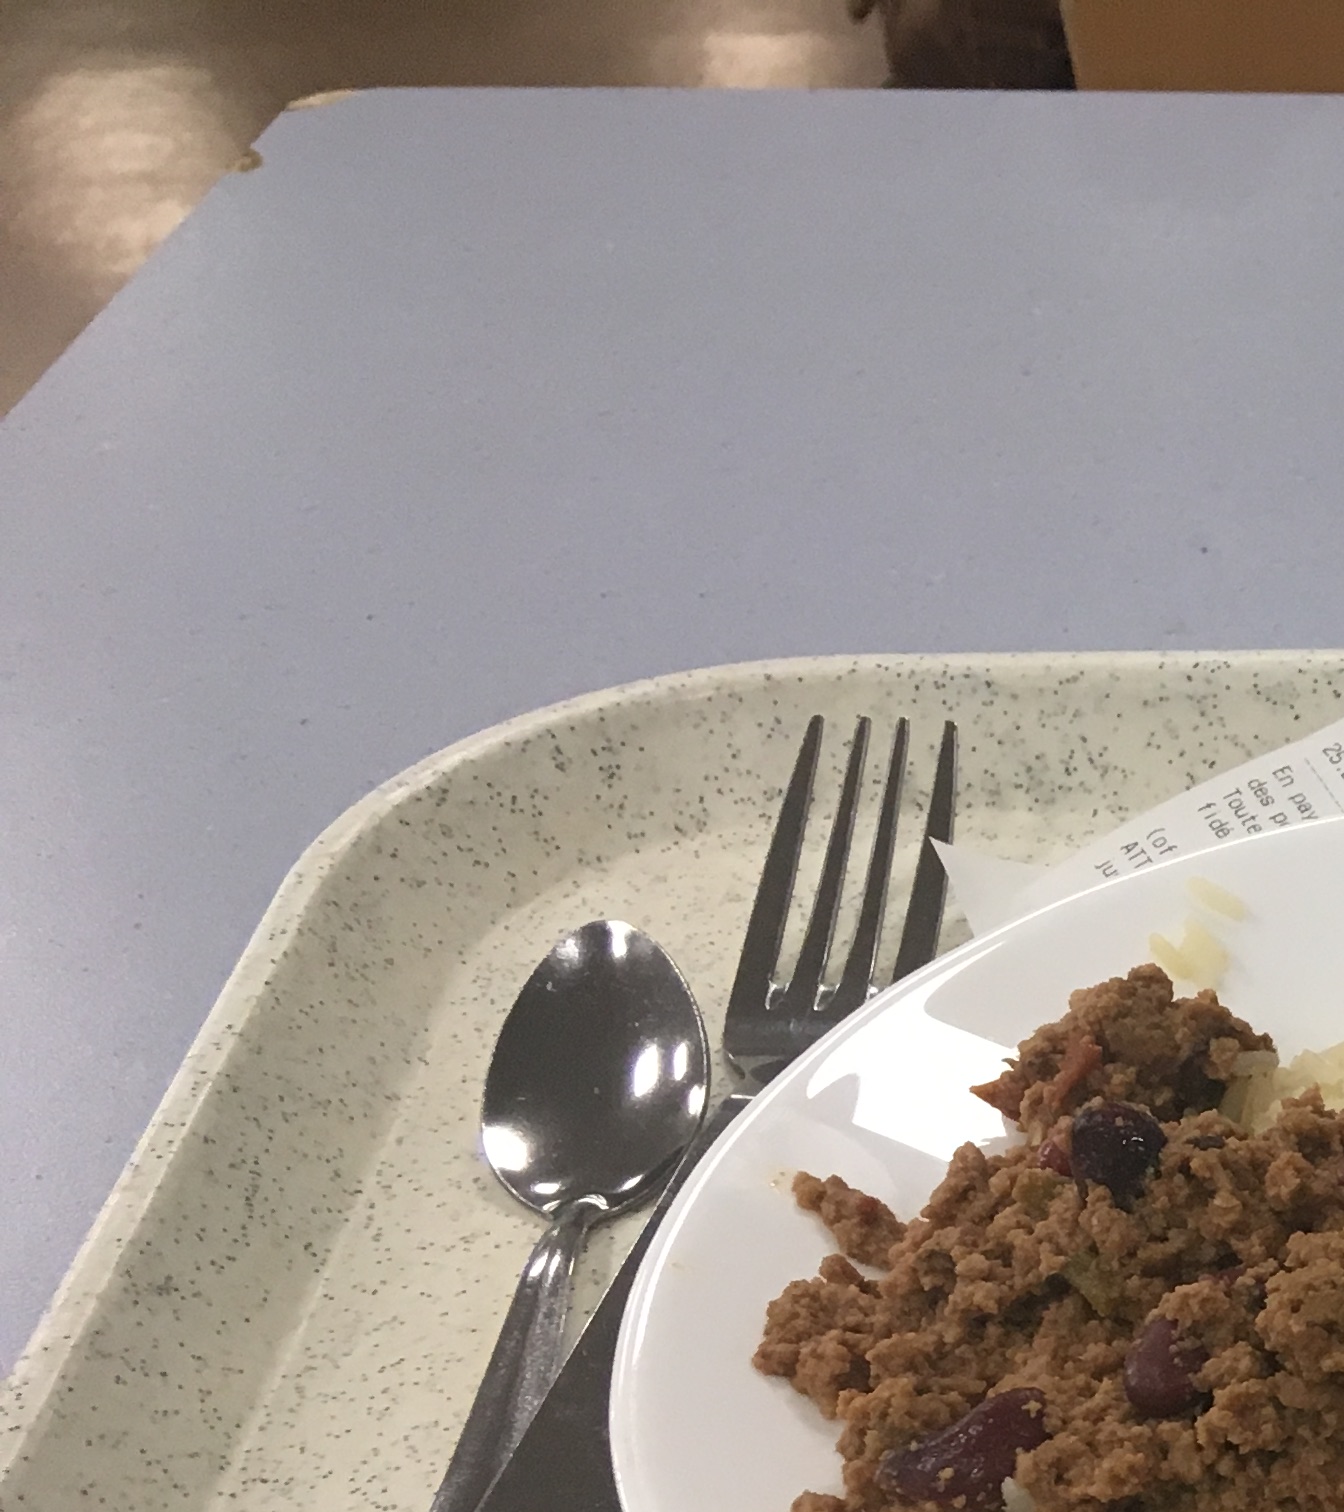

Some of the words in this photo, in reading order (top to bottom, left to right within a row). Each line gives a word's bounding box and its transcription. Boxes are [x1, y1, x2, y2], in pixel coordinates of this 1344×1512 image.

[1247, 777, 1276, 807] des
[1271, 765, 1296, 788] En
[1287, 792, 1320, 821] pay
[1196, 802, 1236, 840] fidé
[1222, 786, 1264, 835] Toute
[1119, 841, 1154, 869] ATT
[1146, 827, 1179, 856] (of
[1094, 859, 1120, 879] ju
